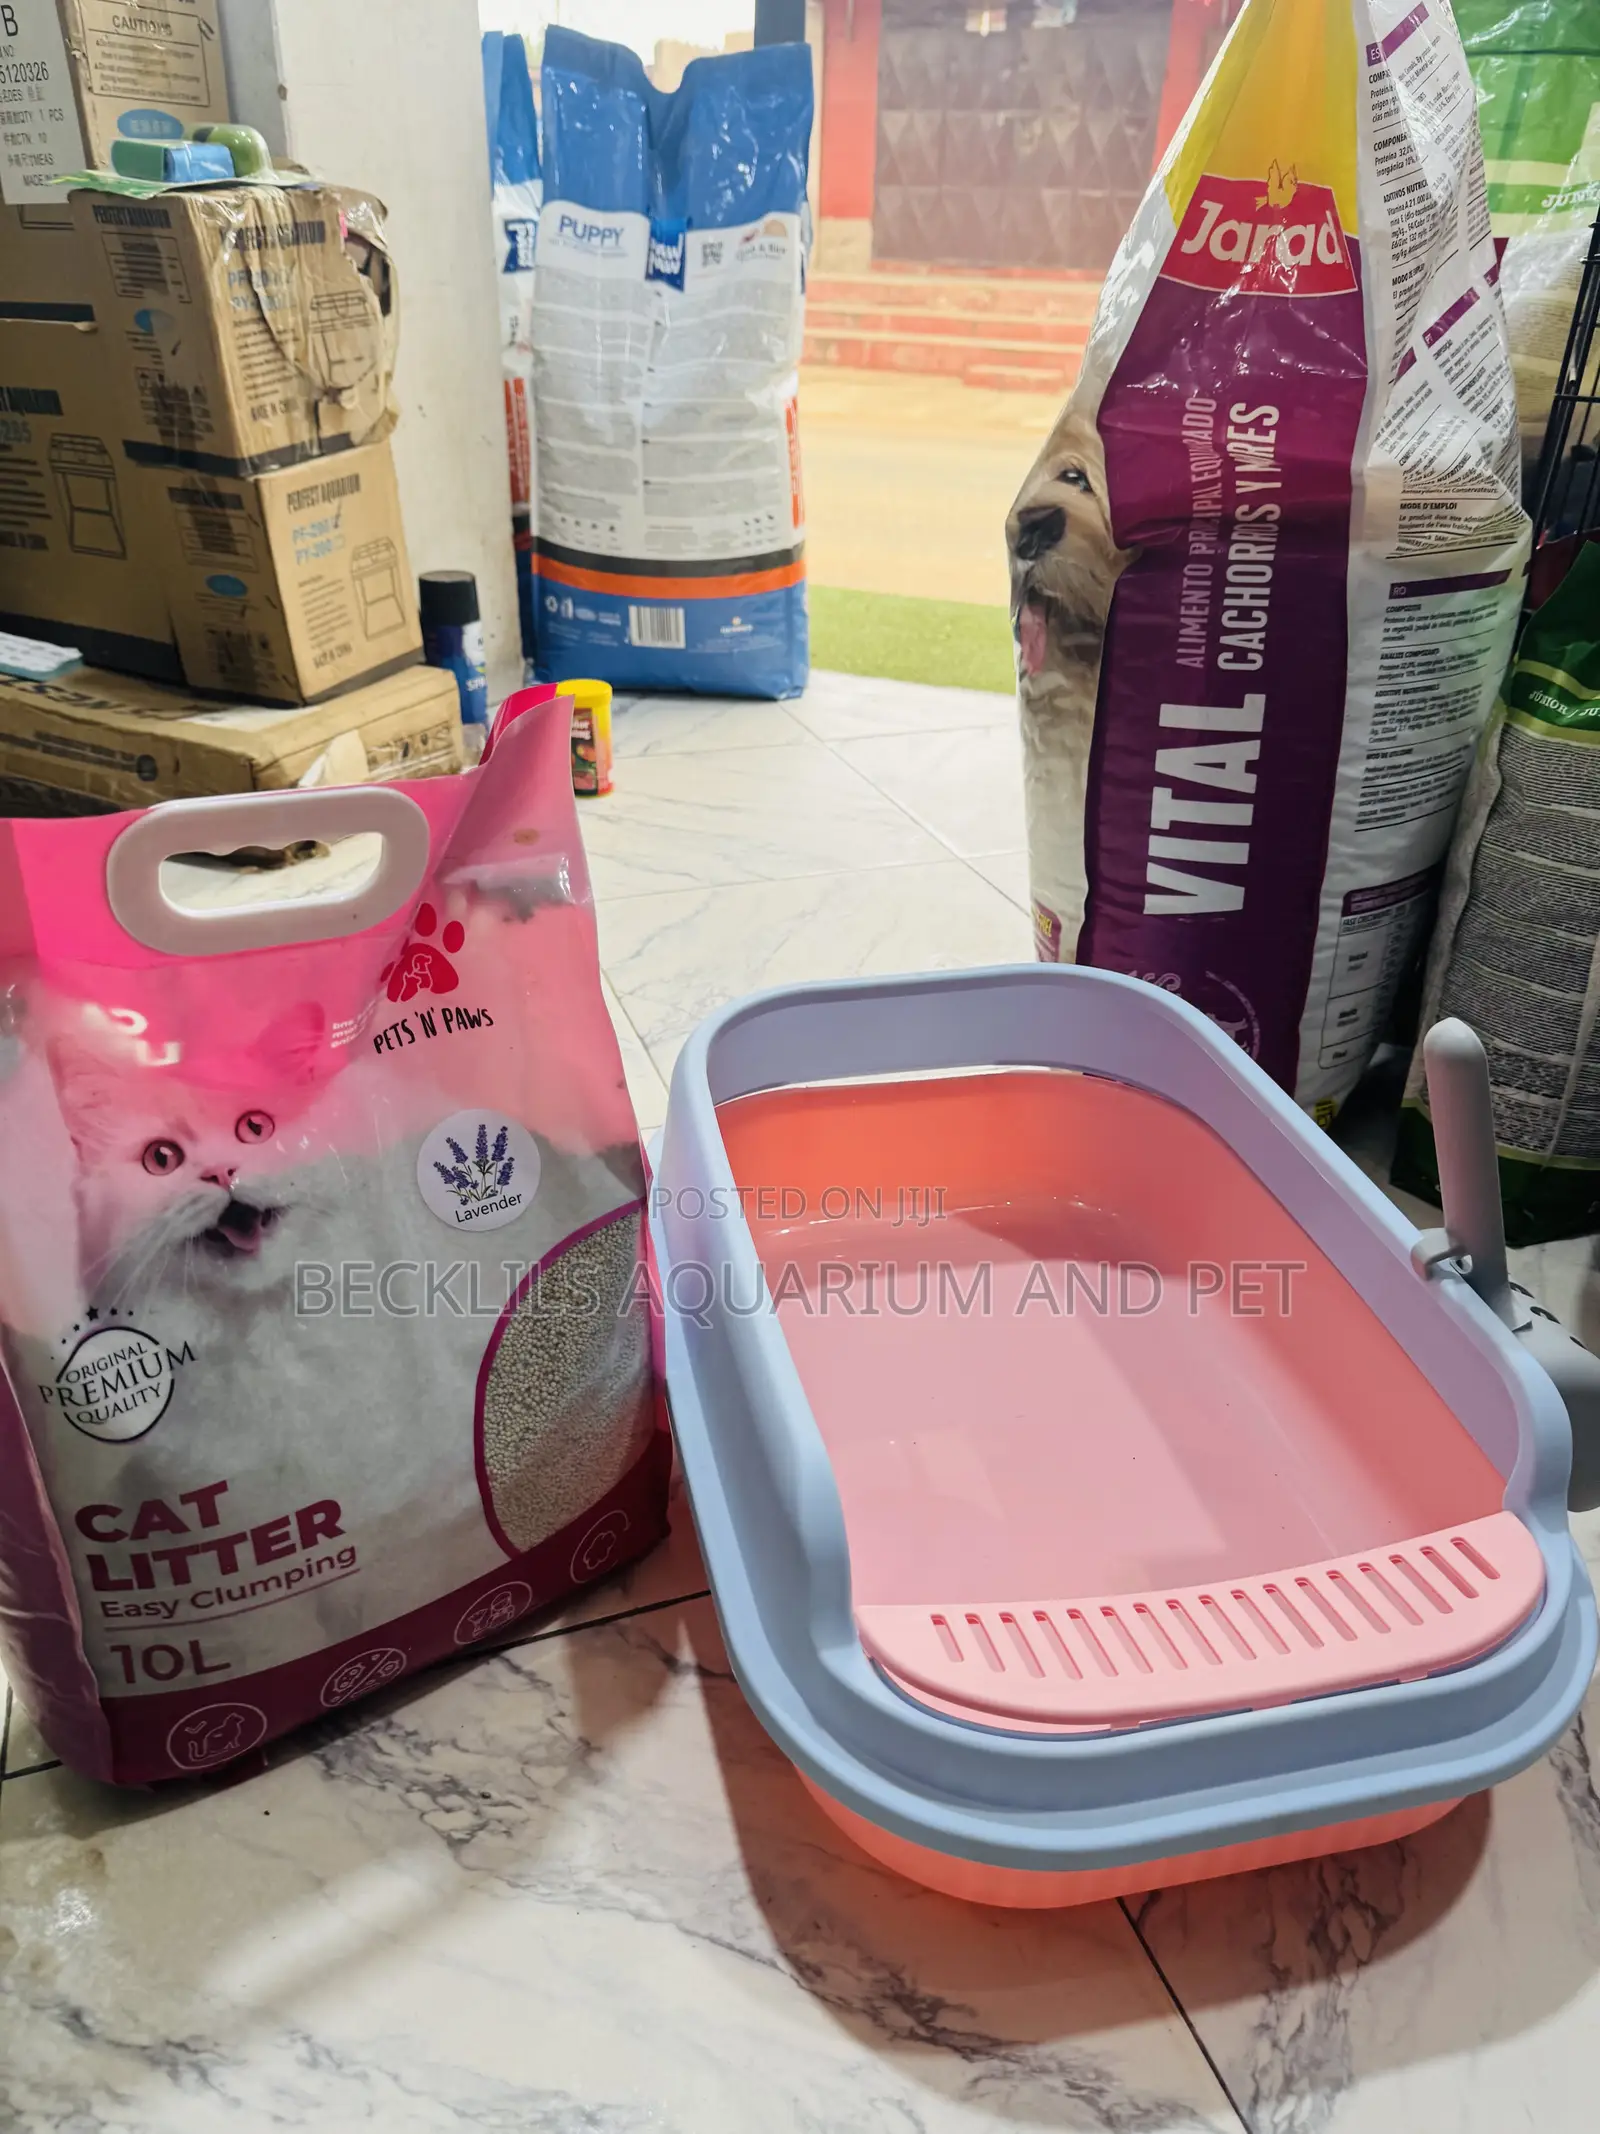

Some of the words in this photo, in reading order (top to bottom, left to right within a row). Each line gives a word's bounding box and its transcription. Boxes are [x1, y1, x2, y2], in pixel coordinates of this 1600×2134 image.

[559, 215, 626, 246] PUPPY
[1180, 199, 1349, 267] Jarad
[287, 485, 320, 514] PERFECT
[1235, 480, 1282, 494] Y
[1400, 502, 1421, 510] MODE
[1422, 502, 1458, 510] D'EMPLOI
[1217, 503, 1281, 671] CACHORROS
[1176, 563, 1214, 669] ALIMENTO
[1579, 707, 1600, 717] JU
[1143, 693, 1266, 915] VITAL
[373, 1018, 416, 1054] PETS
[441, 1006, 494, 1034] PAWS
[455, 1193, 522, 1223] Lavender
[38, 1340, 198, 1407] PREMIUM
[65, 1342, 148, 1384] ORIGINAL
[76, 1382, 161, 1425] QUALITY
[74, 1480, 229, 1543] CAT
[85, 1499, 346, 1592] LITTER
[101, 1600, 181, 1620] Easy
[190, 1545, 358, 1610] Clumping
[110, 1640, 231, 1684] 10L
